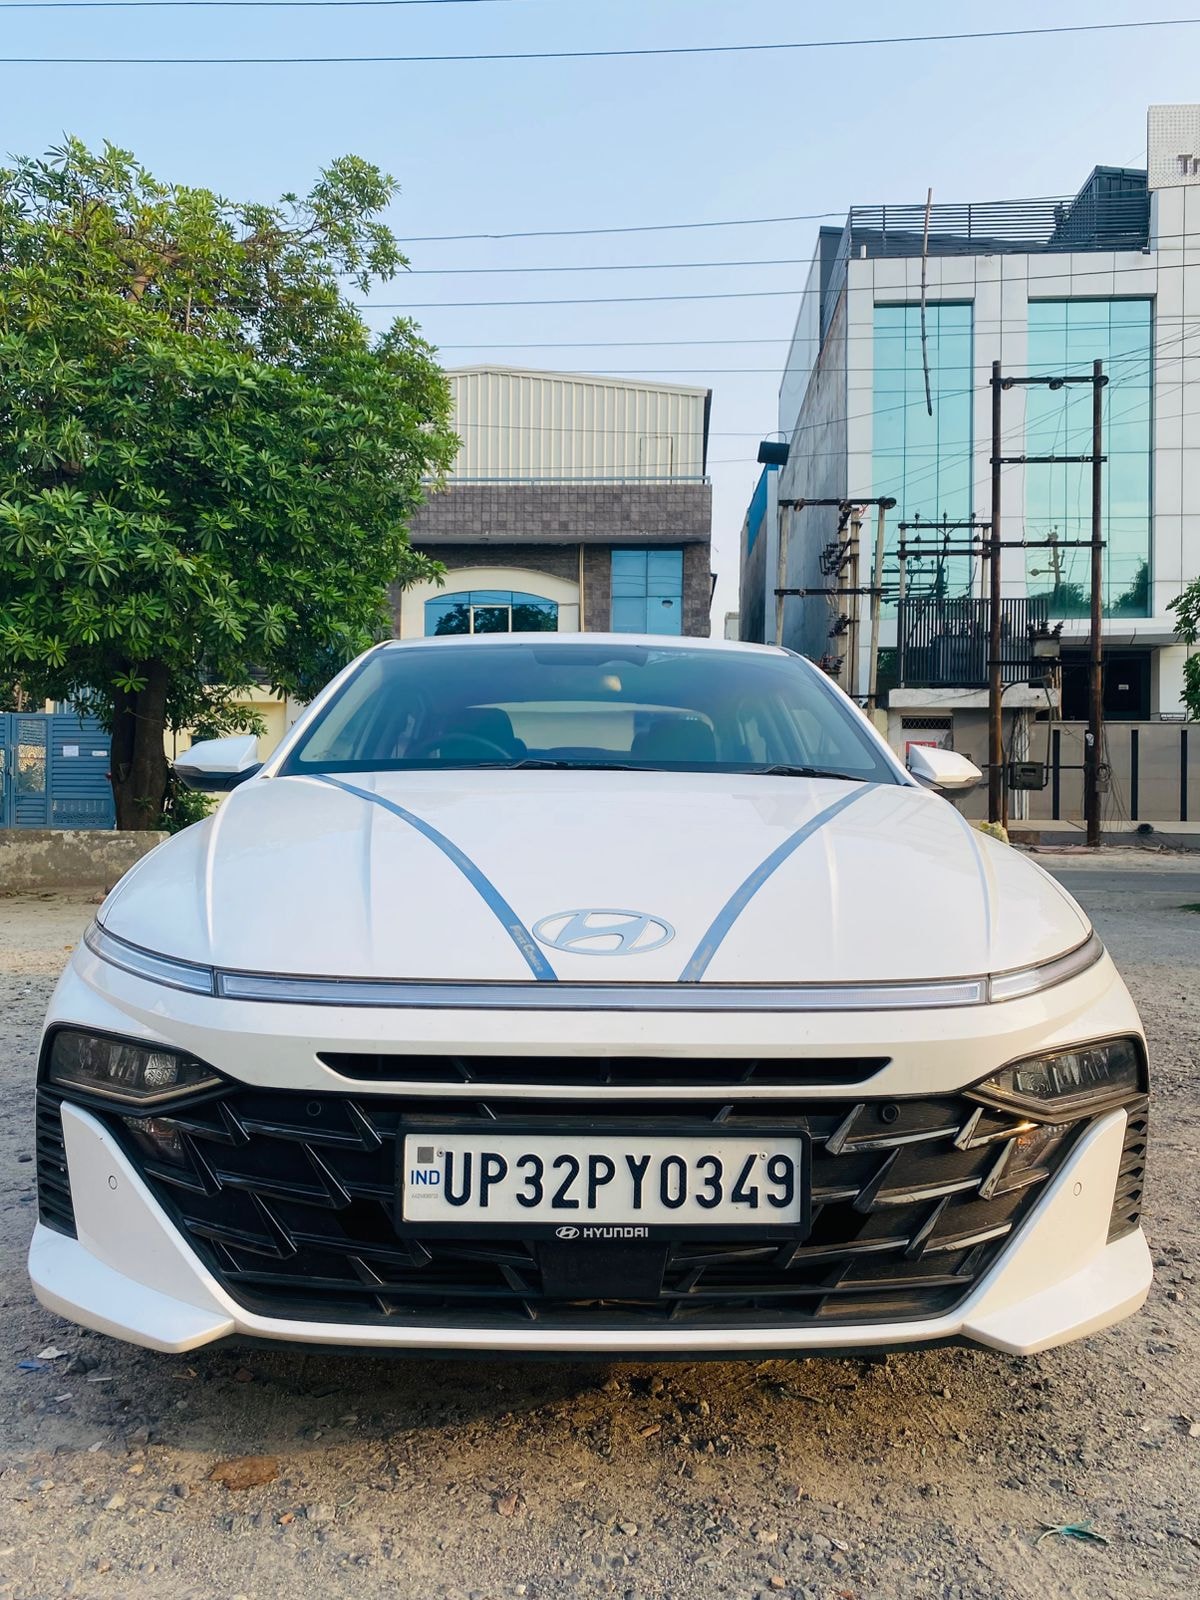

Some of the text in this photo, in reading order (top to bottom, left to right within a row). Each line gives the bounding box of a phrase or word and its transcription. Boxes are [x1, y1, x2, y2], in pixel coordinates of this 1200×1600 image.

[411, 1170, 440, 1185] IND
[444, 1151, 794, 1209] UP32PY0349
[583, 1226, 649, 1238] HYUNDAI
